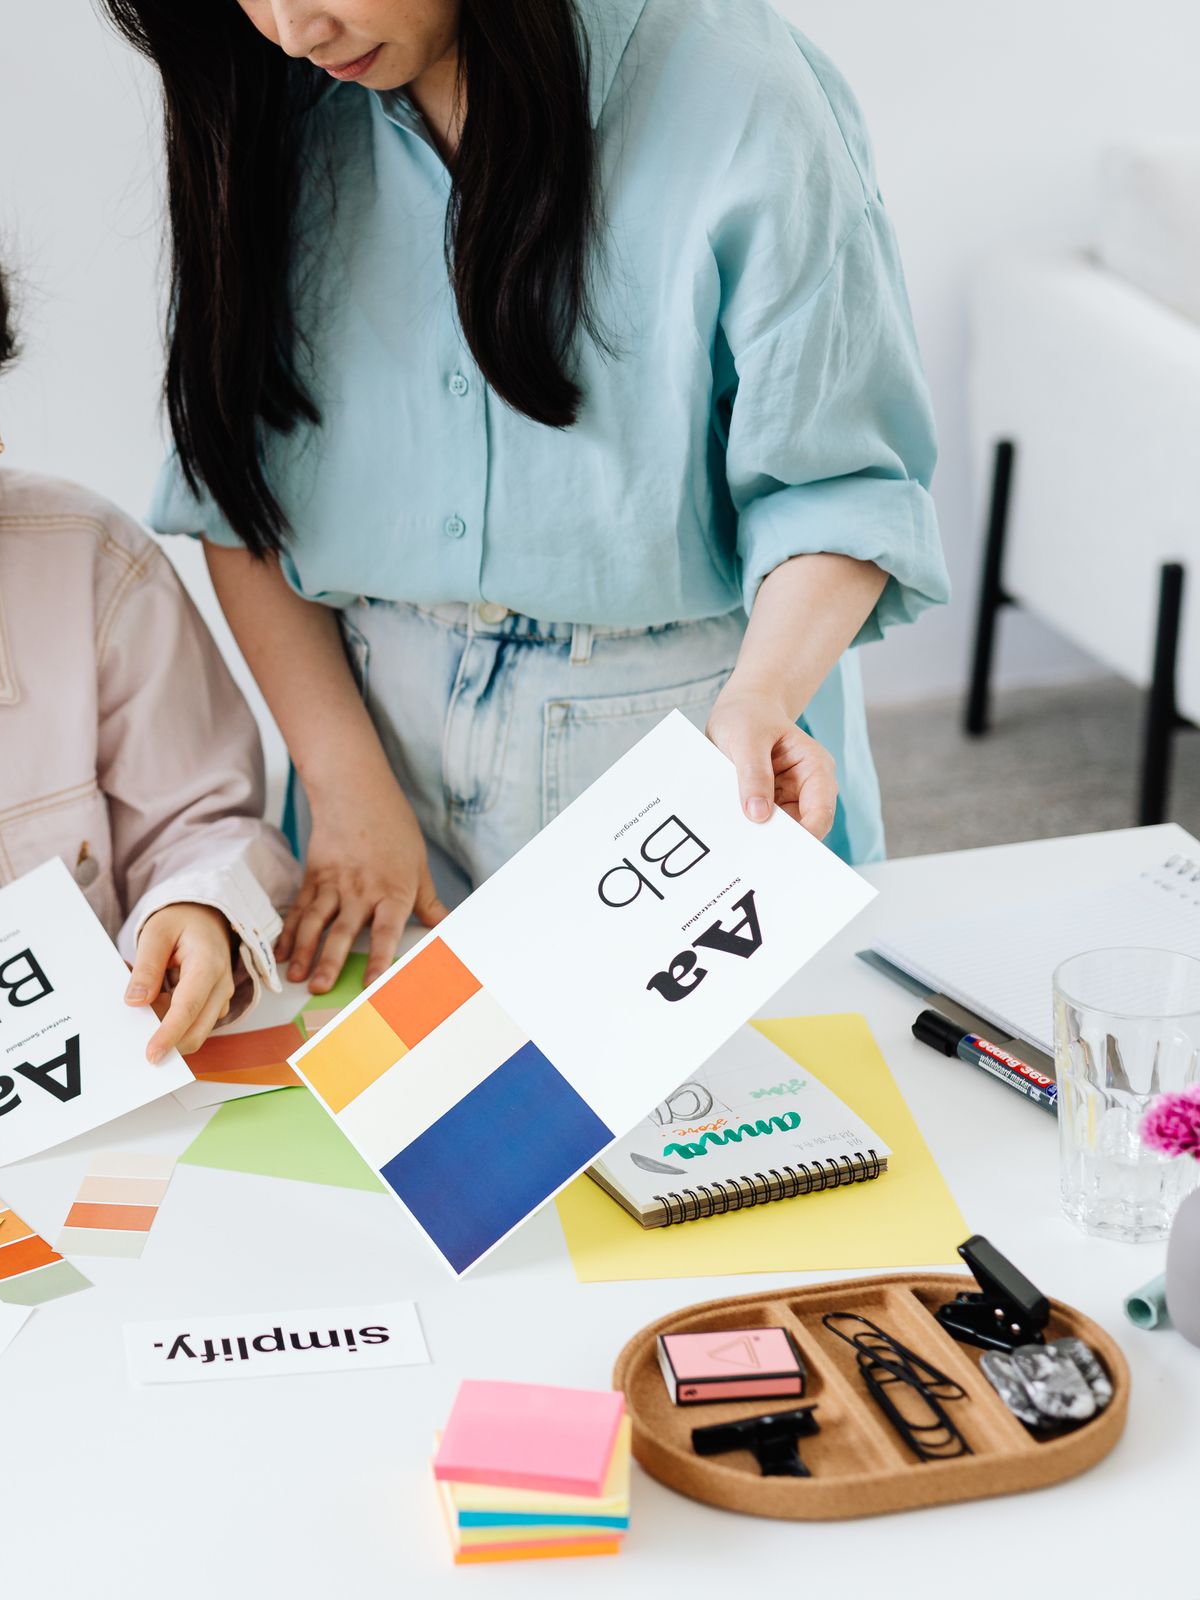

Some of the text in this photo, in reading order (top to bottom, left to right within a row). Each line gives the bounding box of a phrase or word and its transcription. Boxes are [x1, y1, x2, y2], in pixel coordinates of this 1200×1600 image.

[614, 797, 661, 841] Promo Regular
[598, 814, 710, 907] Bb
[681, 877, 741, 931] Servus ExtraBold
[646, 889, 762, 1002] Aa
[978, 1040, 1050, 1084] edding 360
[663, 1111, 801, 1159] anna
[154, 1325, 390, 1363] simplify.
